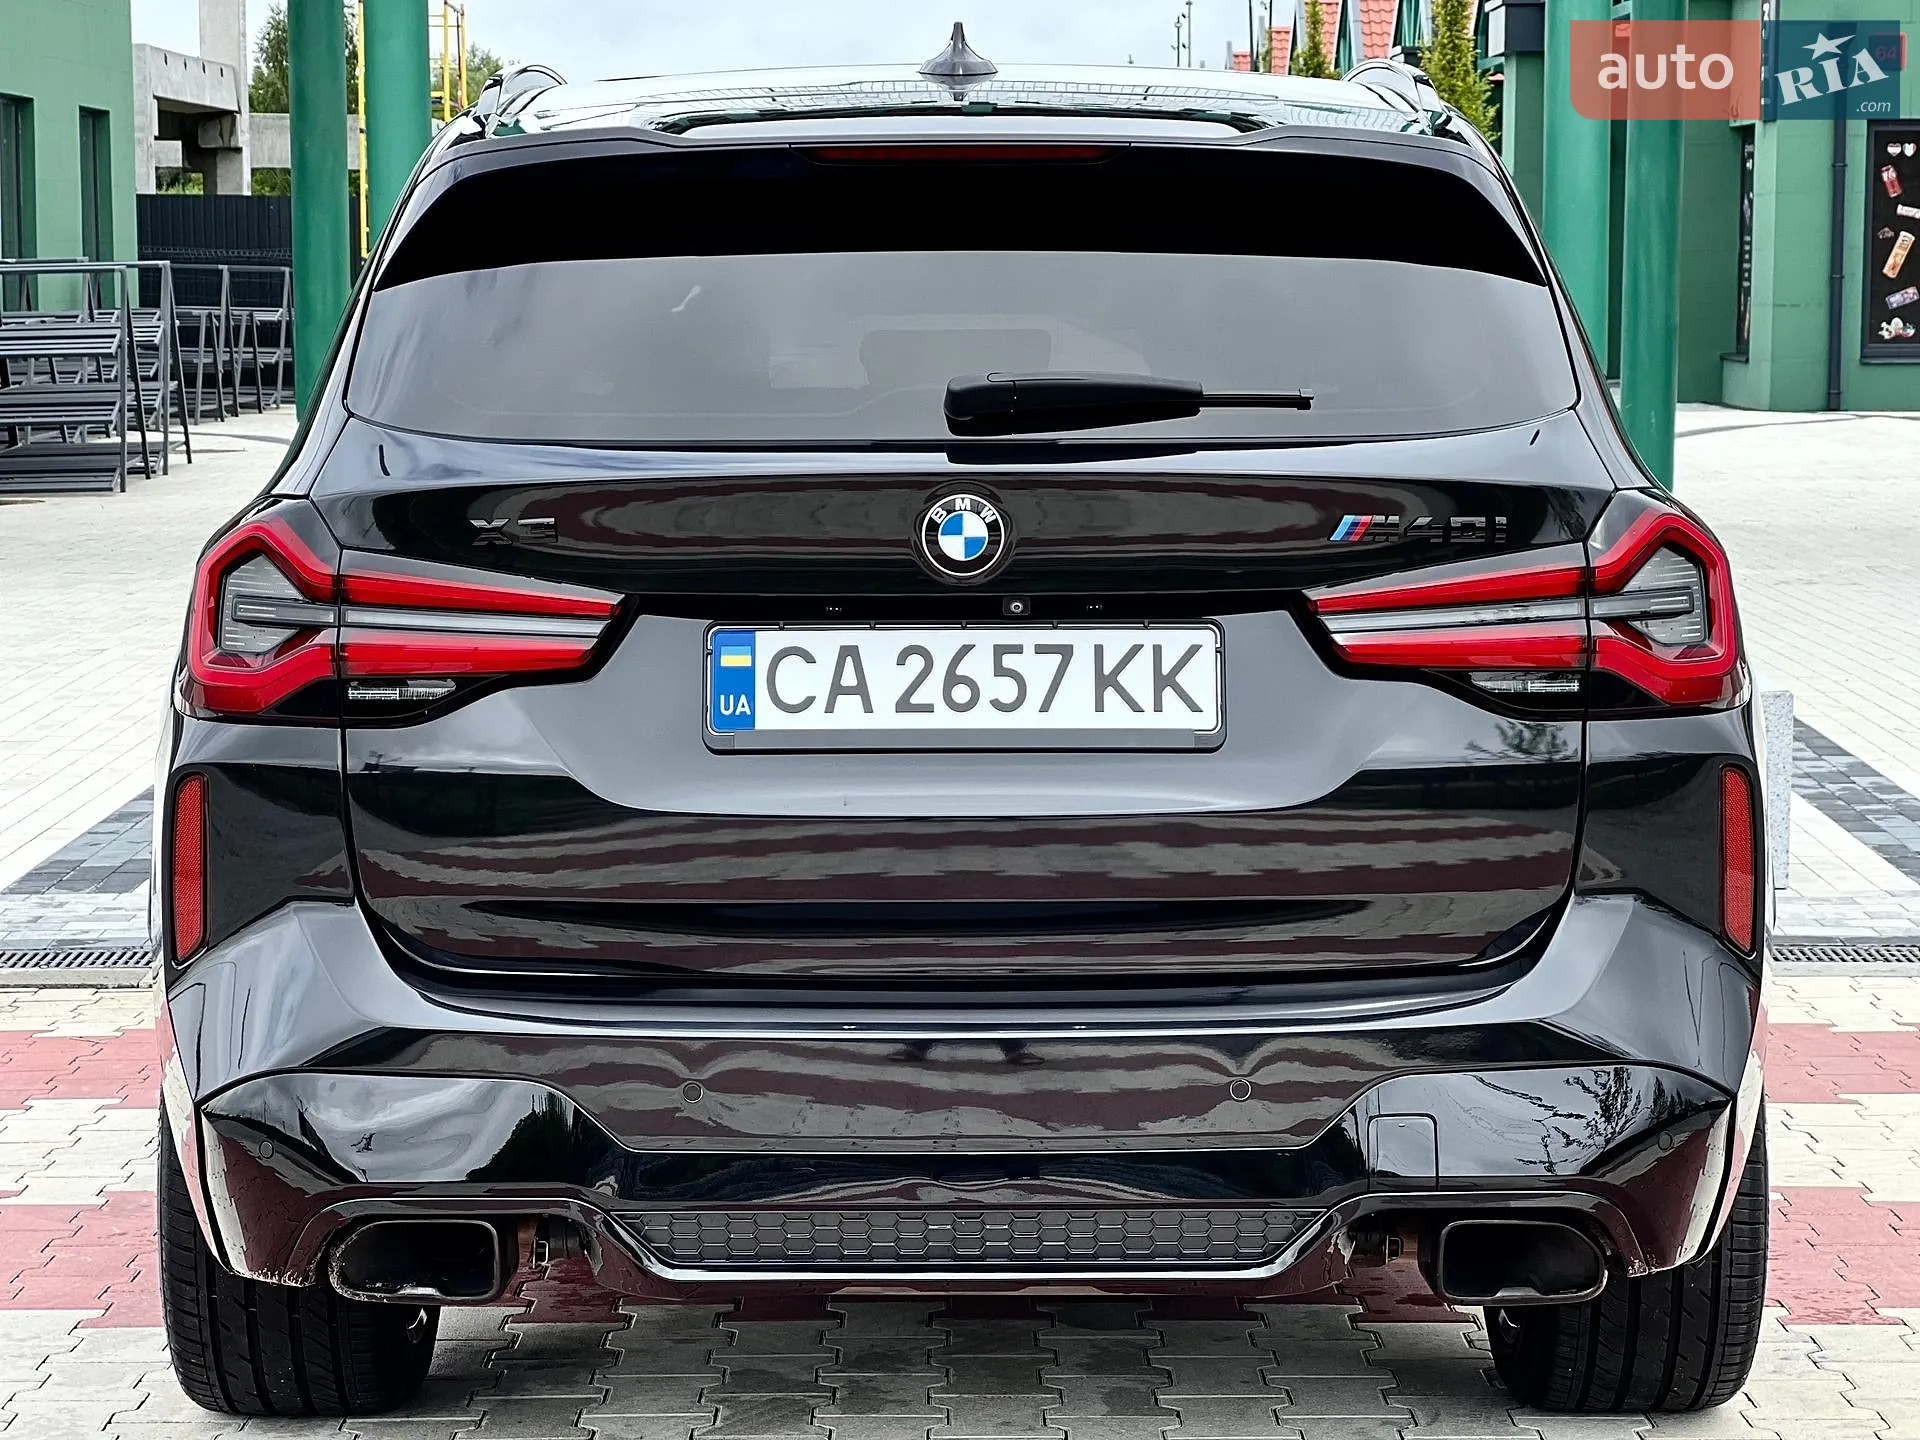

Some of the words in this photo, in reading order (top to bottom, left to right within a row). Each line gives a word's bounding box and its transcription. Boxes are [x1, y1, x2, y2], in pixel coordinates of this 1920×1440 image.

[1875, 46, 1897, 60] 64
[930, 497, 997, 524] BMW
[469, 517, 558, 546] X3
[766, 644, 874, 714] CA
[895, 644, 1074, 714] 2657
[1094, 644, 1204, 714] KK
[719, 694, 752, 717] UA
